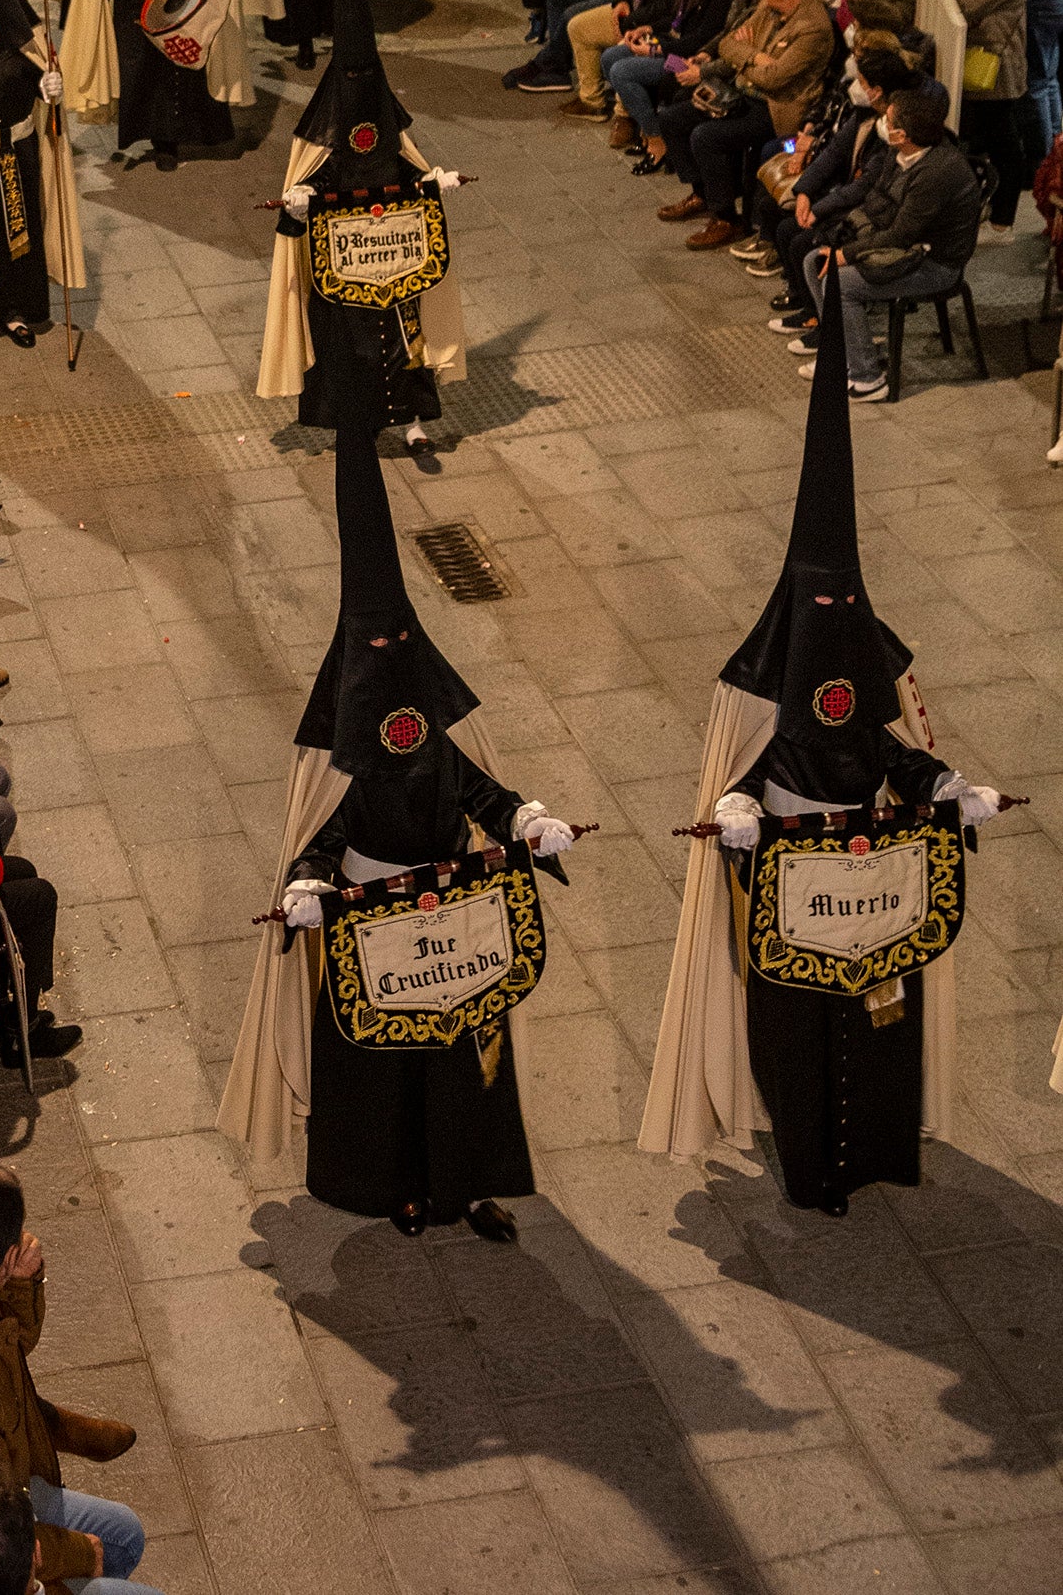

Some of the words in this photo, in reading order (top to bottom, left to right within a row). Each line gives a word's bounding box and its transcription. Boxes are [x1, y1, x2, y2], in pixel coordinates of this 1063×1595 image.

[341, 252, 354, 267] al
[808, 893, 900, 917] Muerto
[413, 936, 457, 960] Fue
[379, 950, 500, 995] Crucificado
